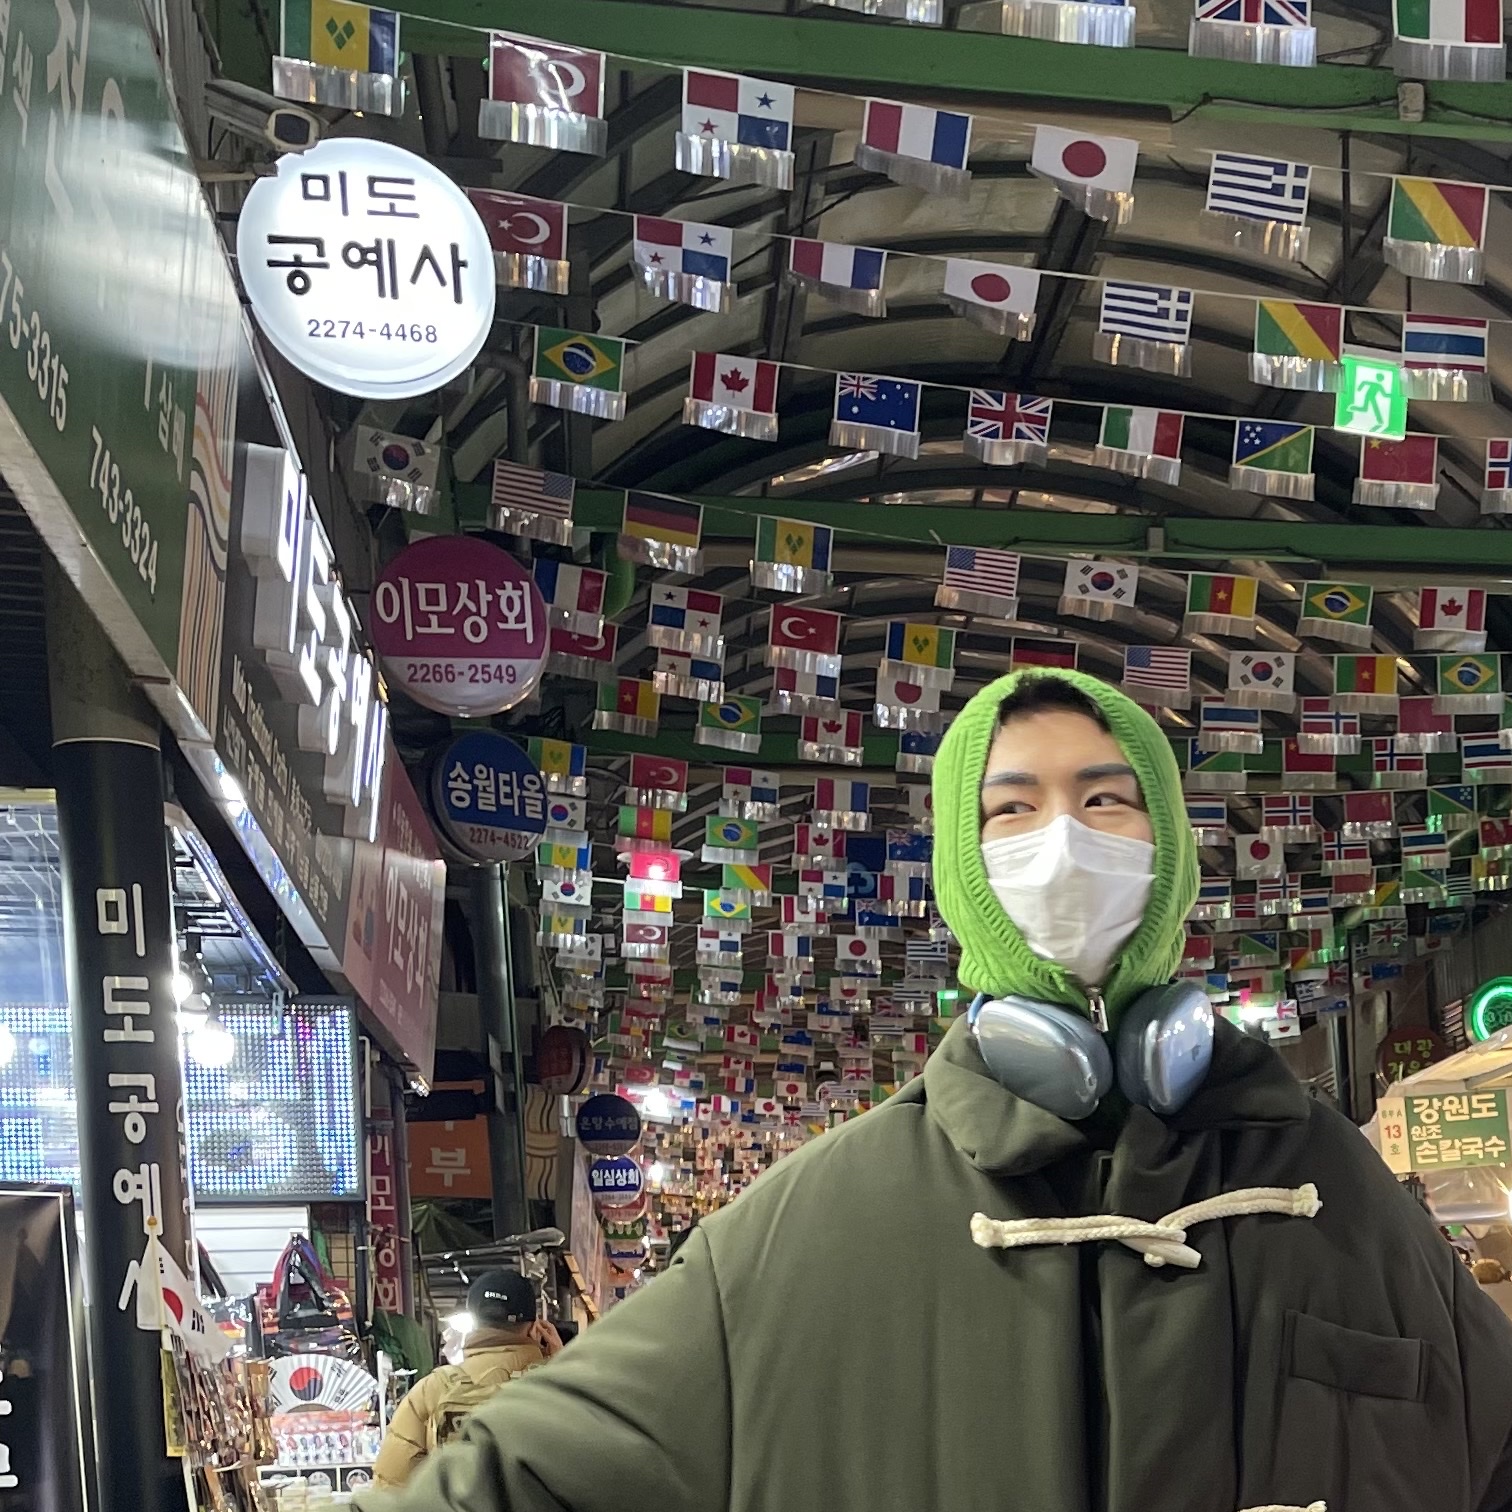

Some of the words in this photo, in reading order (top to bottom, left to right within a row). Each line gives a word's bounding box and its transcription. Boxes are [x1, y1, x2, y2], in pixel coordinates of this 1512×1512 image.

[301, 170, 420, 218] 미도
[266, 233, 468, 304] 공예사
[307, 318, 439, 344] 2274-4468
[90, 425, 158, 595] 743-3324
[375, 575, 534, 644] 이모상회
[407, 663, 517, 685] 2266-2549
[448, 761, 544, 820] 송월타올
[469, 827, 530, 850] 2274-4522
[385, 865, 428, 1009] 이모상회
[1413, 1093, 1499, 1123] 강원도
[1384, 1124, 1402, 1139] 13
[1411, 1125, 1443, 1141] 원조
[1416, 1136, 1506, 1164] 손칼국수
[592, 1169, 639, 1187] 일심상회
